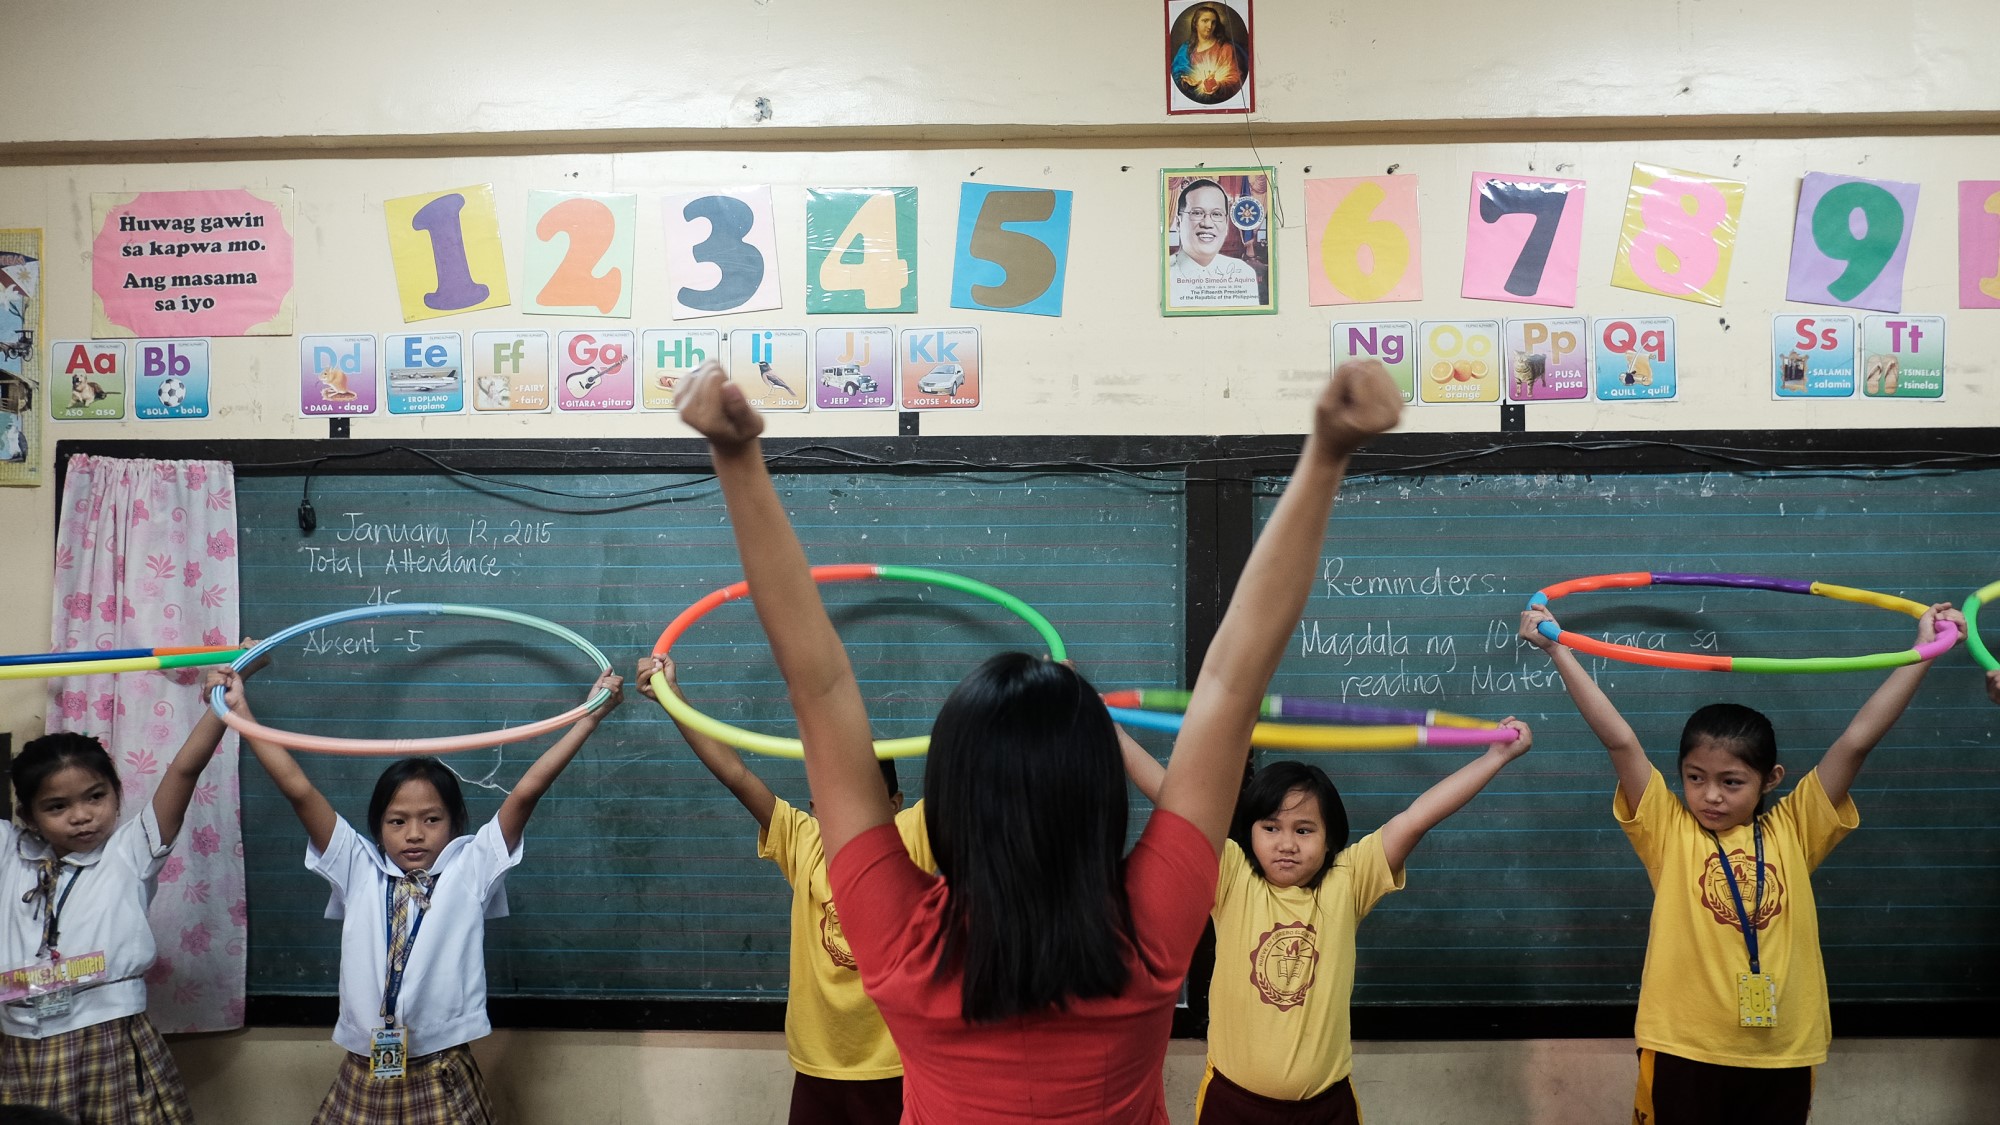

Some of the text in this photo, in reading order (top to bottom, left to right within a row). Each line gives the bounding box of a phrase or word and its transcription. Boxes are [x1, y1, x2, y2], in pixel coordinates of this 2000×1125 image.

[119, 212, 264, 233] Huwag gawin
[1480, 178, 1568, 297] 7
[1631, 180, 1726, 295] 8
[122, 239, 266, 257] sa kapwa mo.
[412, 193, 489, 310] 1
[536, 198, 621, 314] 2
[677, 195, 764, 311] 3
[820, 193, 909, 309] 4
[970, 190, 1056, 308] 5
[1322, 181, 1408, 301] 6
[1812, 181, 1904, 302] 9
[123, 272, 258, 291] Ang masama
[154, 295, 215, 312] sa iyo
[752, 331, 772, 364] Ii
[837, 332, 869, 366] Jj
[910, 332, 960, 363] Kk
[1348, 327, 1403, 364] Ng
[1430, 325, 1491, 358] Oo
[1523, 323, 1576, 365] Pp
[1603, 321, 1665, 361] Qq
[1795, 319, 1838, 350] Ss
[1886, 321, 1923, 353] Tt
[65, 344, 116, 374] Aa
[144, 344, 190, 376] Bb
[313, 343, 361, 373] Dd
[405, 337, 447, 367] Ee
[494, 339, 524, 374] Ff
[568, 334, 622, 375] Gg
[657, 337, 705, 368] Hh
[520, 384, 544, 392] FAIRY
[1555, 370, 1581, 378] PUSA
[1555, 380, 1583, 391] pusa
[1814, 380, 1850, 389] salamin
[1904, 381, 1939, 389] tsinelas
[521, 396, 544, 406] fairy
[602, 399, 631, 409] gitara
[863, 396, 885, 405] jeep
[950, 396, 975, 404] kotse
[1647, 386, 1669, 396] quill
[181, 406, 202, 414] bola
[344, 403, 369, 412] daga
[409, 403, 445, 411] eroplano
[337, 512, 450, 556] January
[503, 519, 554, 545] 2015
[305, 547, 502, 578] Total Attendance
[1324, 556, 1506, 599] Reminders:
[303, 628, 380, 657] Absent
[1300, 619, 1409, 666] Magdala
[1427, 634, 1457, 673] ng
[1690, 629, 1718, 652] sa
[1341, 658, 1446, 704] reading
[66, 955, 105, 980] Quintero
